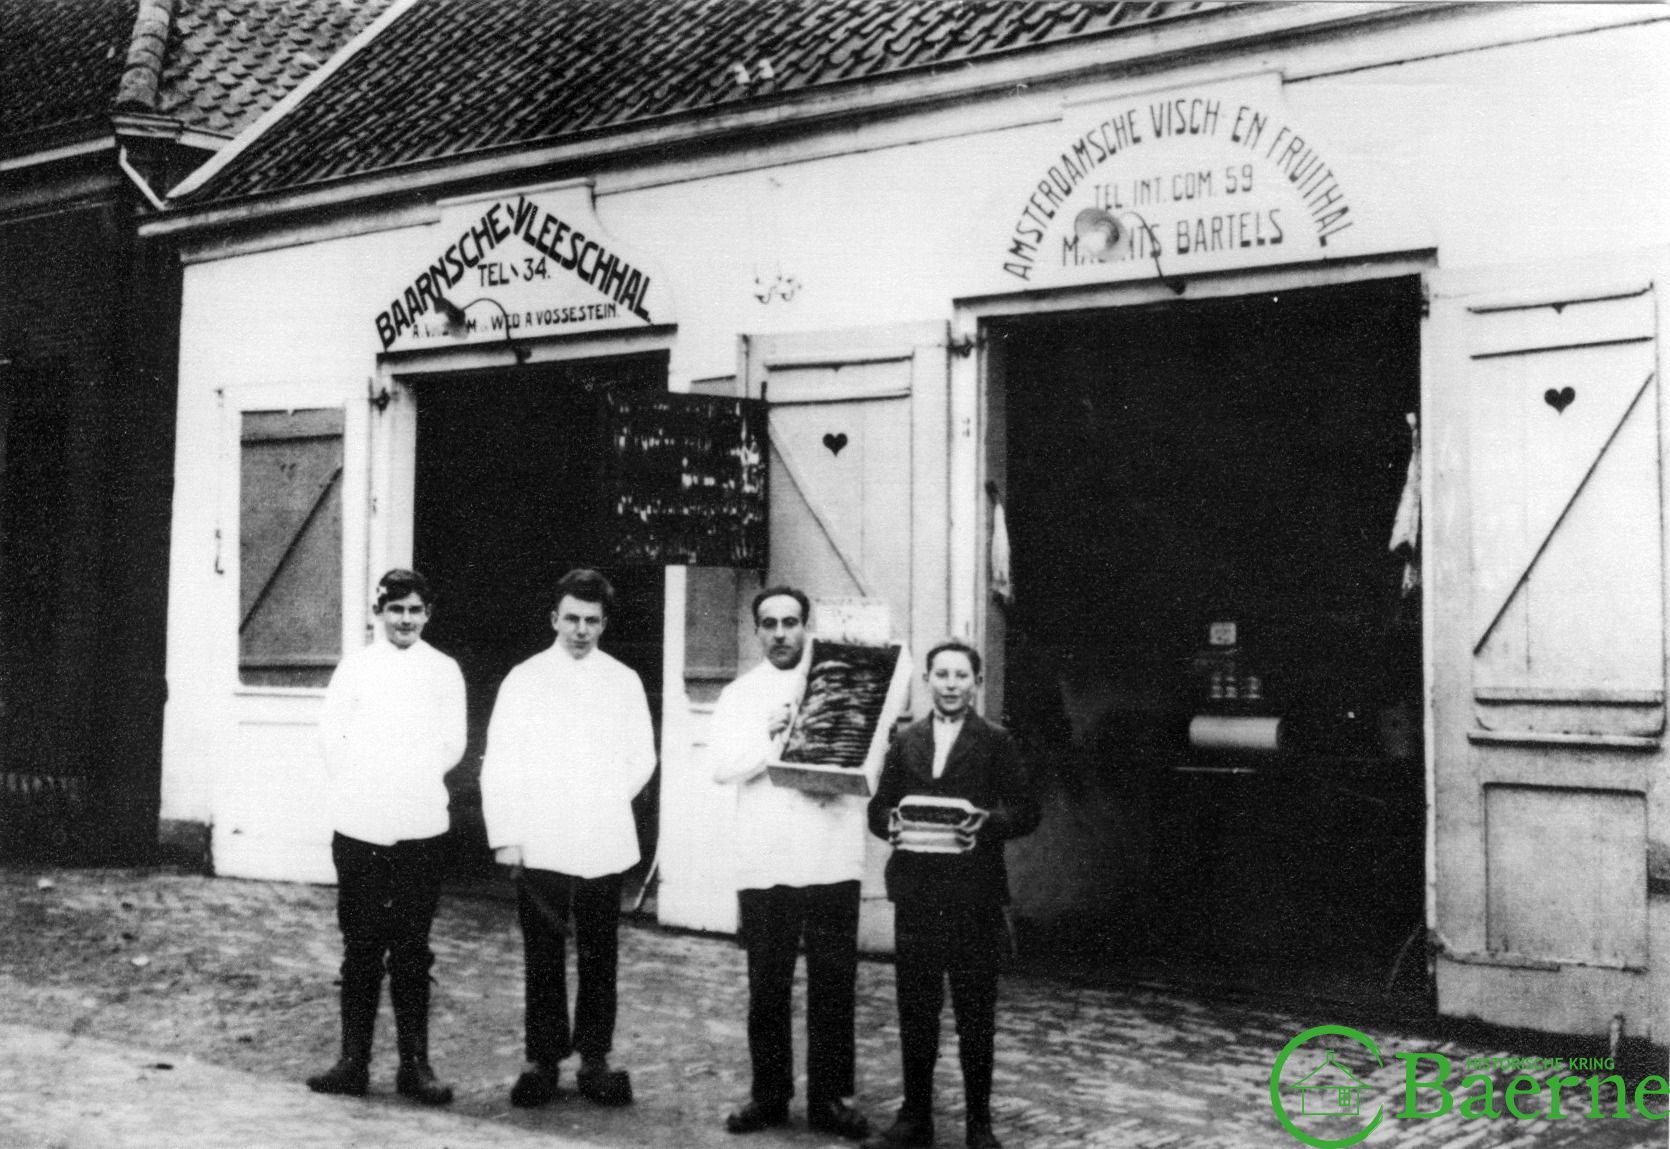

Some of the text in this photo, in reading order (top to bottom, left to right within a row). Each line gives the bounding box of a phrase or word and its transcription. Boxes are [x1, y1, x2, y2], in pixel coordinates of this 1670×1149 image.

[1003, 98, 1353, 281] AMSTERDAMSCHE VISCH EN FRUITHAL
[1226, 164, 1253, 194] 59
[1176, 208, 1283, 255] BARTELS
[375, 195, 653, 352] BAARNSCHE VLEESCHHAL
[536, 302, 616, 326] VOSSESTEIN
